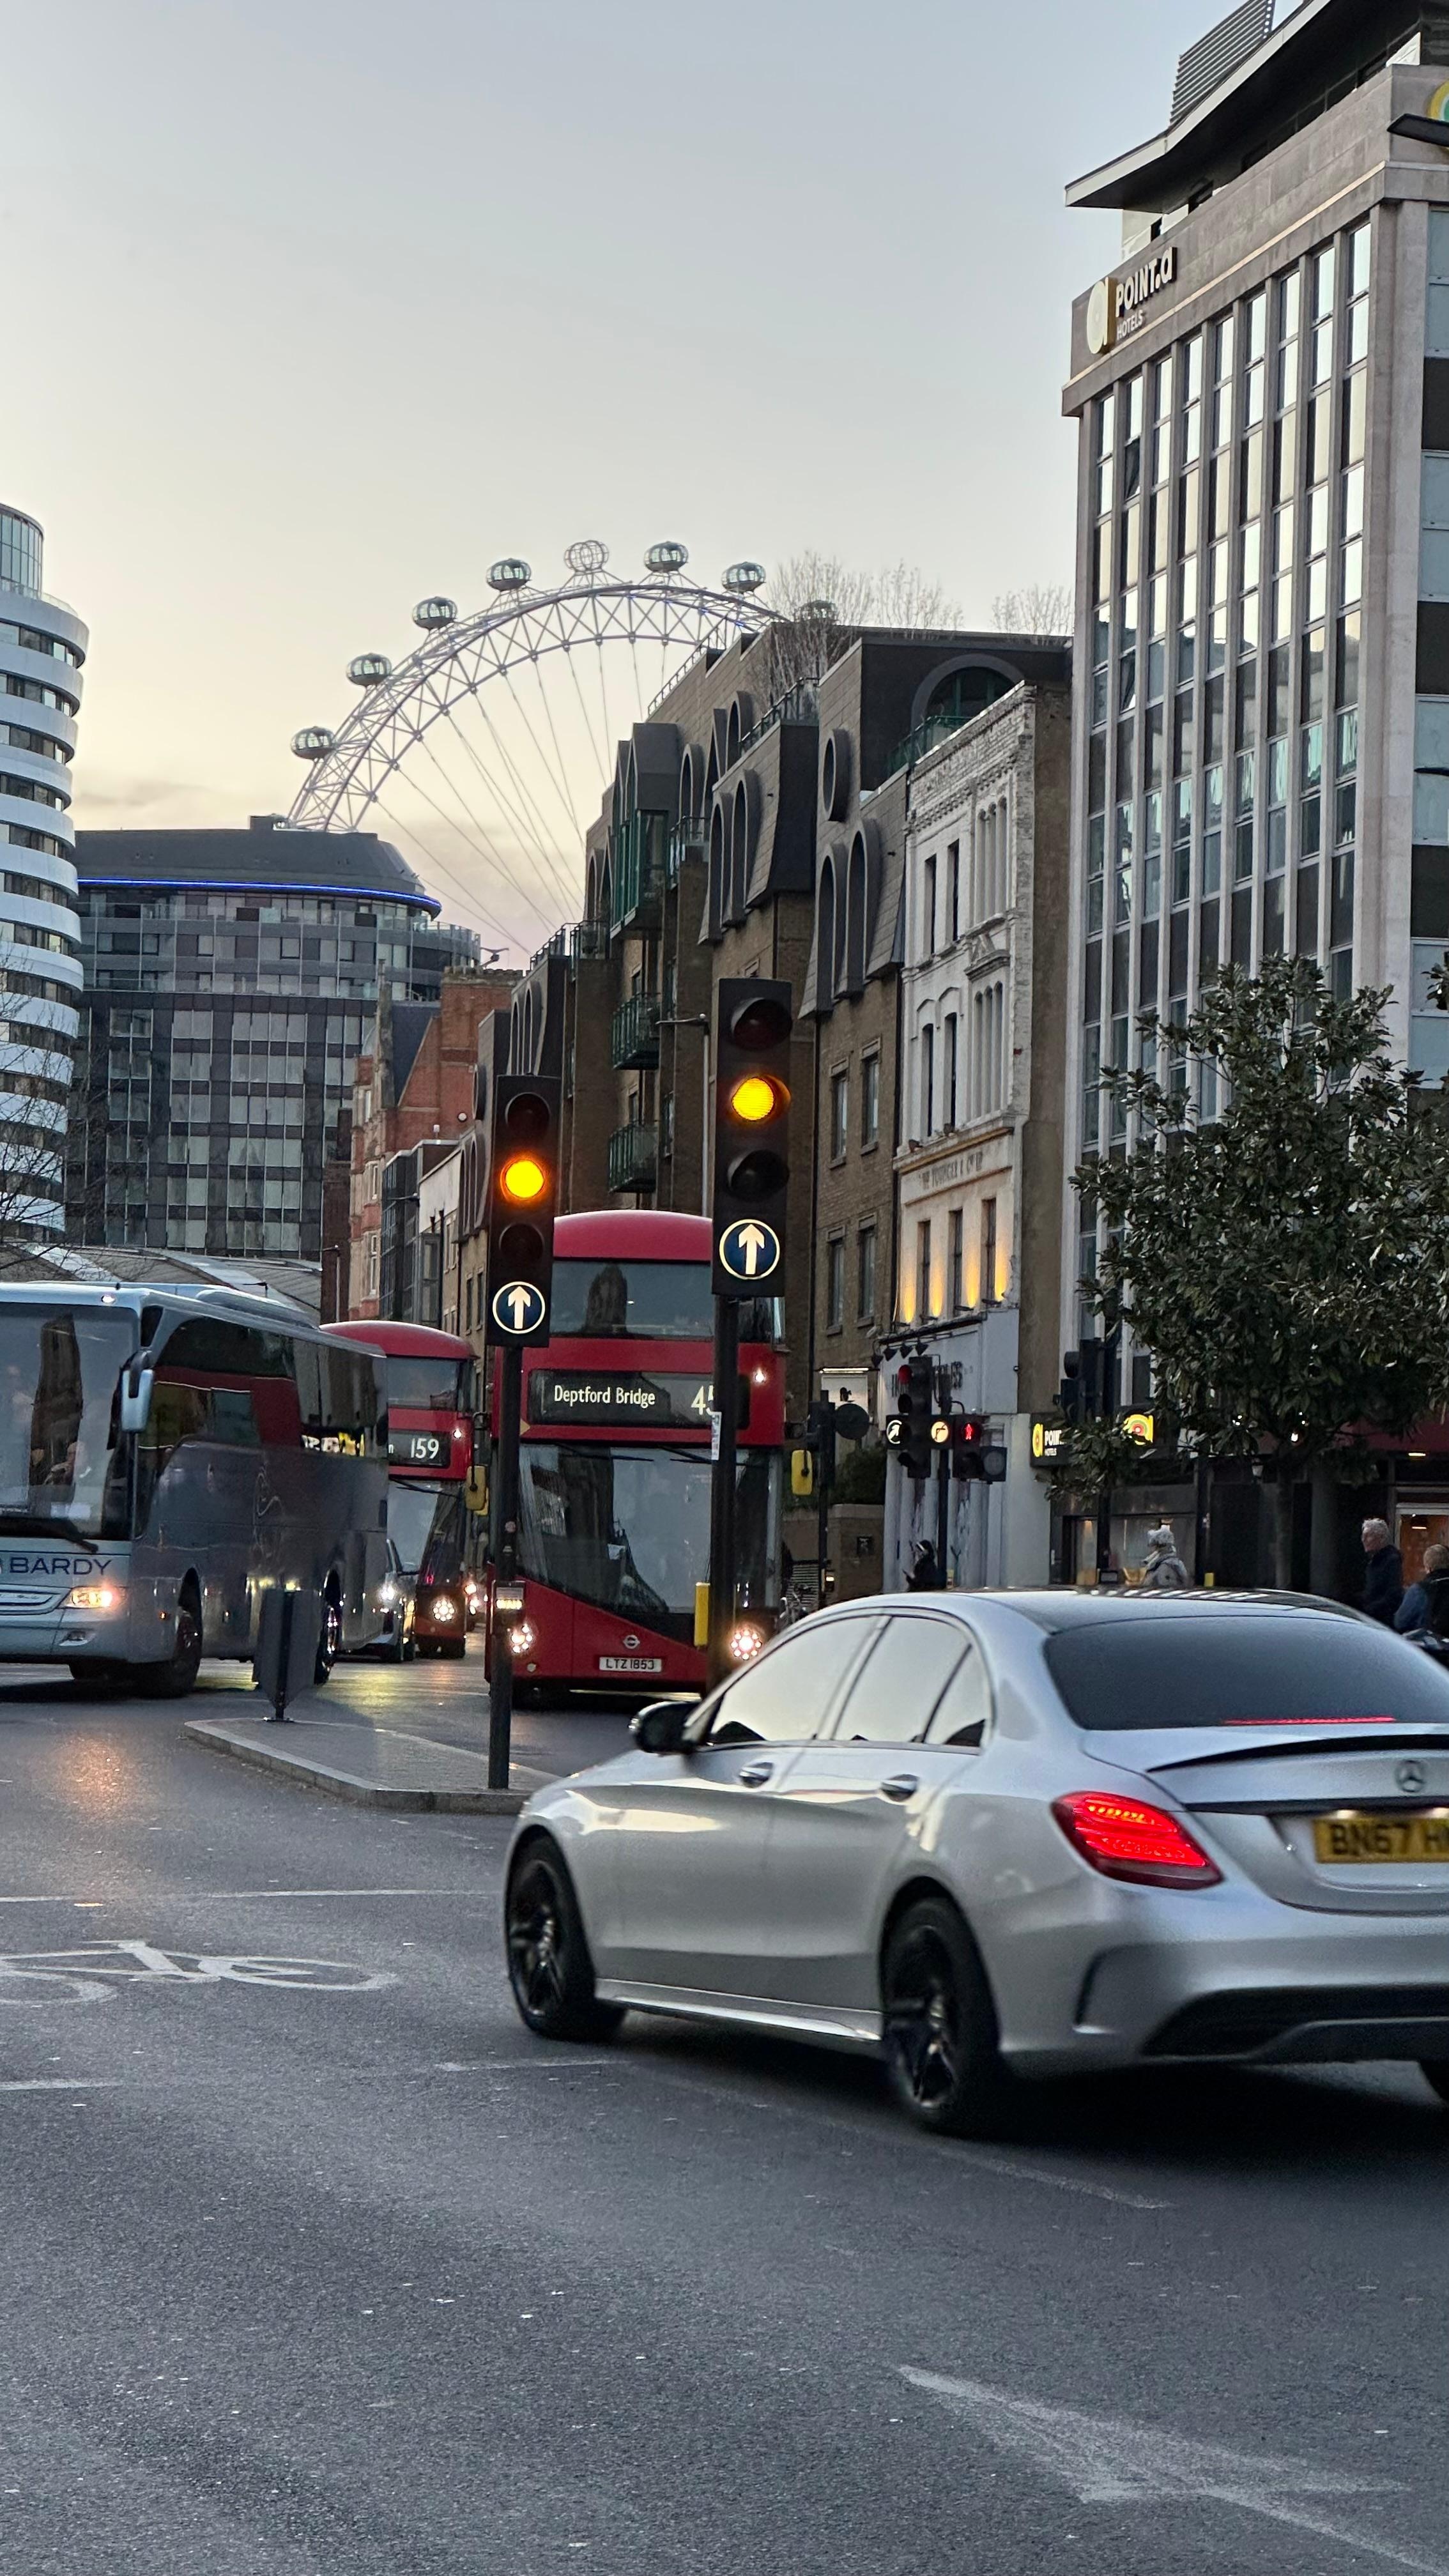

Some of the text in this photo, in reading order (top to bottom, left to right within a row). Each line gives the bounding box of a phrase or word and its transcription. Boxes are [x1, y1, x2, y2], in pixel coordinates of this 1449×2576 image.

[1116, 309, 1144, 340] HOTELS
[555, 1384, 611, 1407] Deptford
[616, 1386, 656, 1409] Bridge
[411, 1438, 439, 1459] 159
[10, 1557, 112, 1575] BARDY
[606, 1659, 627, 1669] LTZ
[1330, 1823, 1411, 1856] BN67
